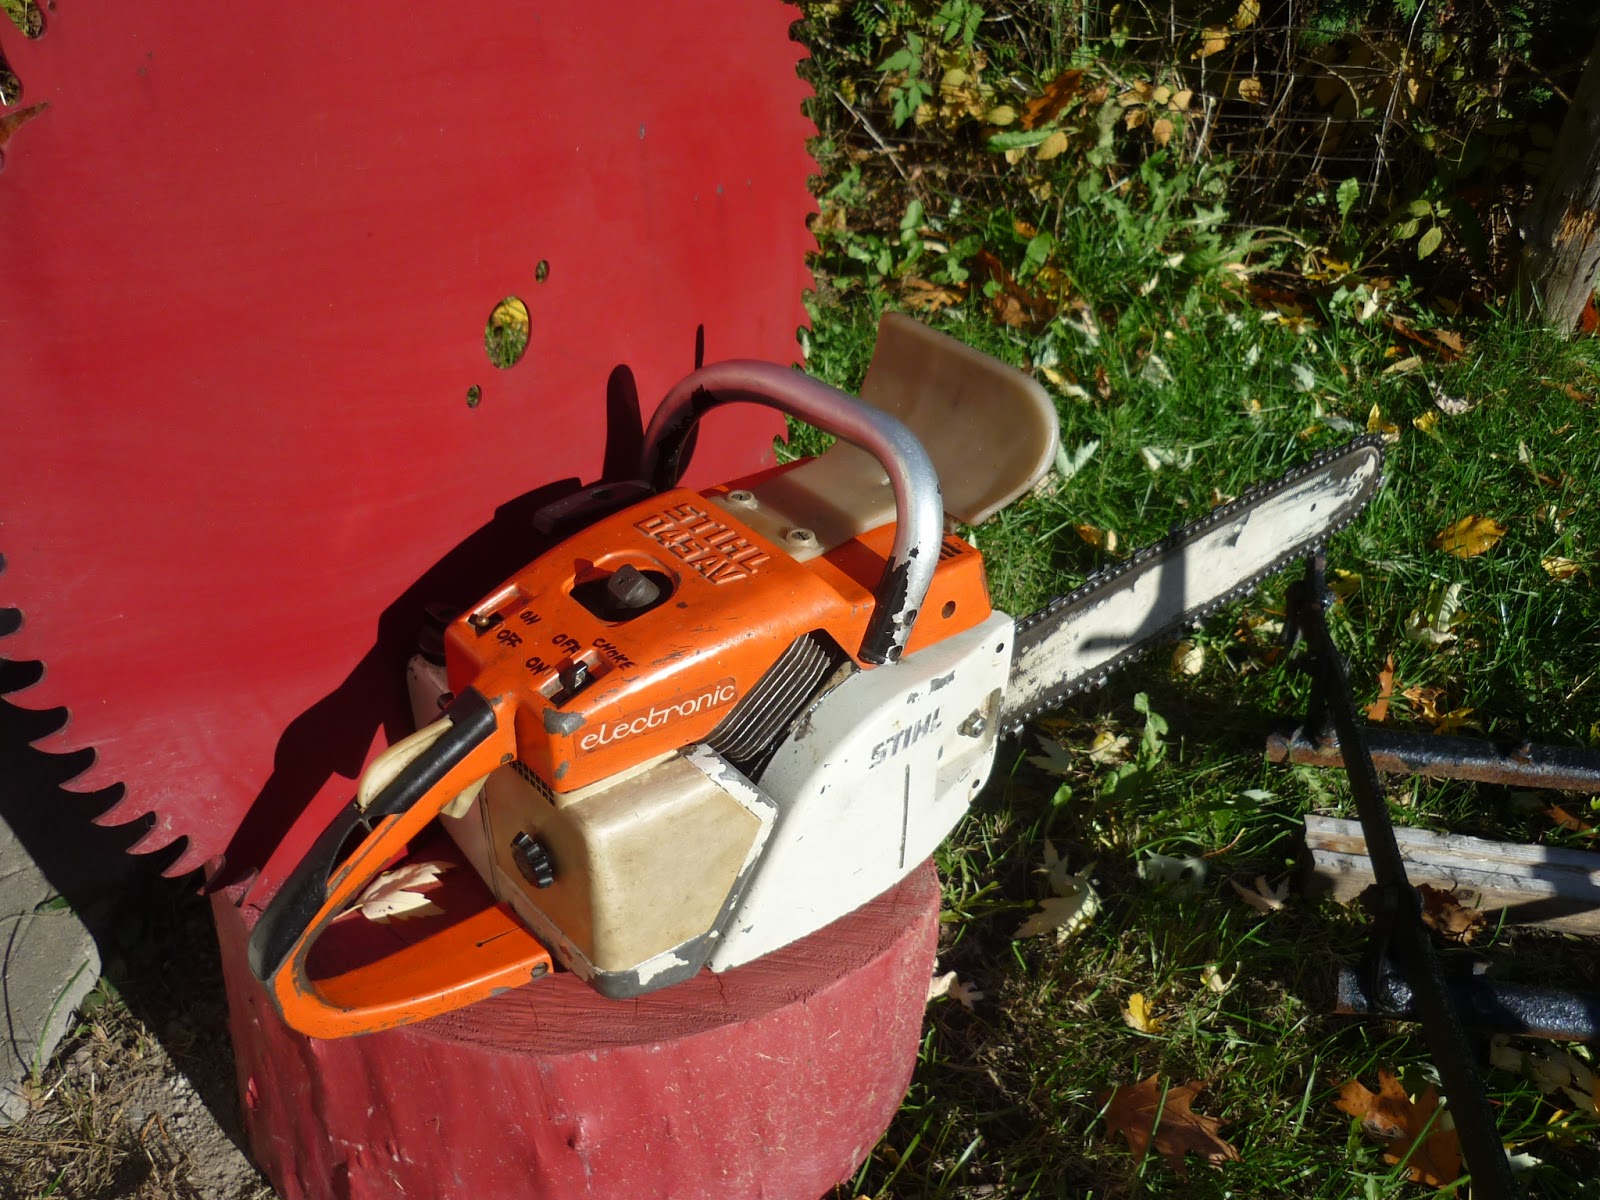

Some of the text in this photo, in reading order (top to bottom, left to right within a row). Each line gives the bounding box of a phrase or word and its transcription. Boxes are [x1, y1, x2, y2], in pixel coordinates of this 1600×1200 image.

[632, 514, 747, 585] 045AV
[663, 502, 771, 574] STIHL
[496, 629, 524, 648] OFF
[519, 610, 542, 626] ON
[551, 633, 582, 654] OFF
[525, 656, 551, 676] ON
[580, 685, 735, 751] electronic
[868, 706, 943, 770] STIHL
